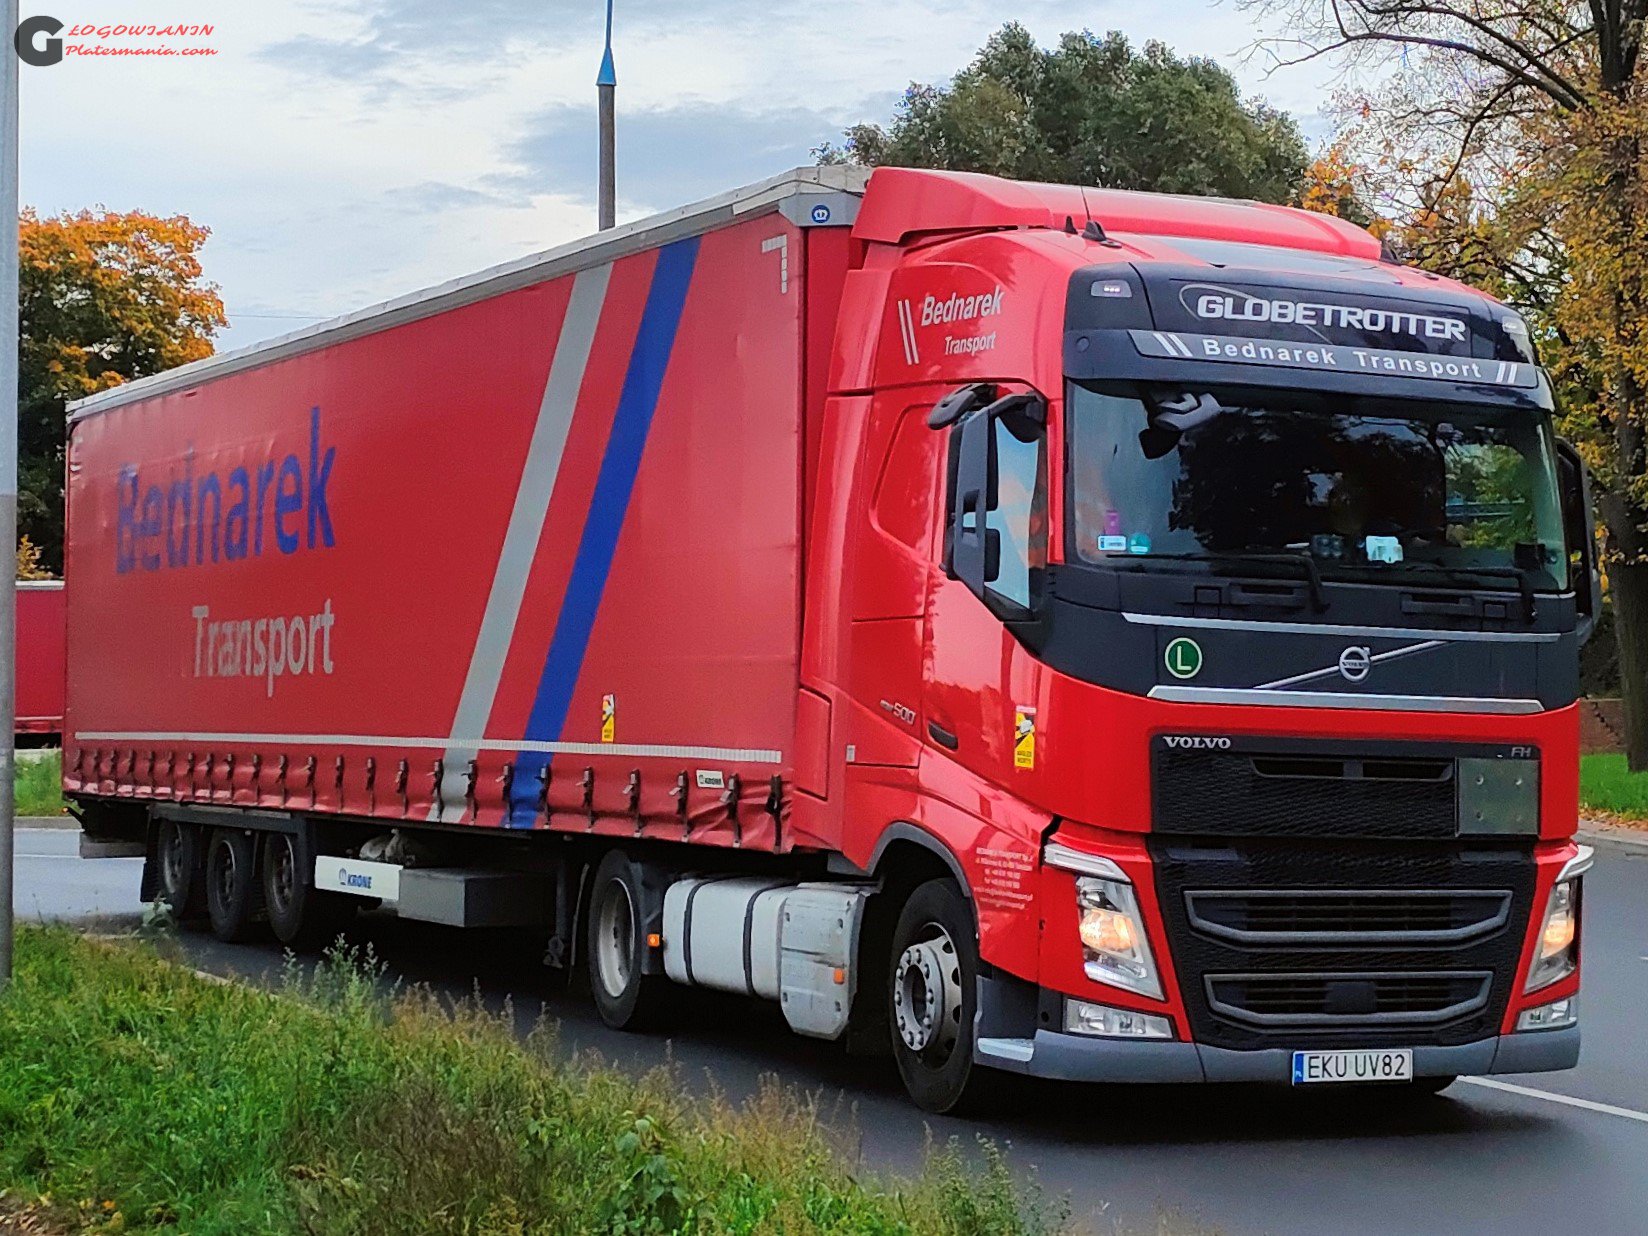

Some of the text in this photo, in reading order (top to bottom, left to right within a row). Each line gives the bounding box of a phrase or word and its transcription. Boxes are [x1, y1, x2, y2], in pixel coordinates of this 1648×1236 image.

[921, 284, 1005, 327] Bednarek
[1197, 294, 1467, 342] GLOBETROTTER
[944, 331, 996, 357] Transport
[1202, 338, 1482, 379] Bednarek Transport
[115, 406, 335, 574] Bednarek
[192, 598, 334, 697] Transport
[1176, 645, 1192, 671] L
[893, 702, 916, 725] 500
[1162, 736, 1232, 749] VOLVO
[1511, 746, 1532, 758] FH
[347, 873, 373, 890] KRONE
[1308, 1053, 1405, 1079] EKU UV82
